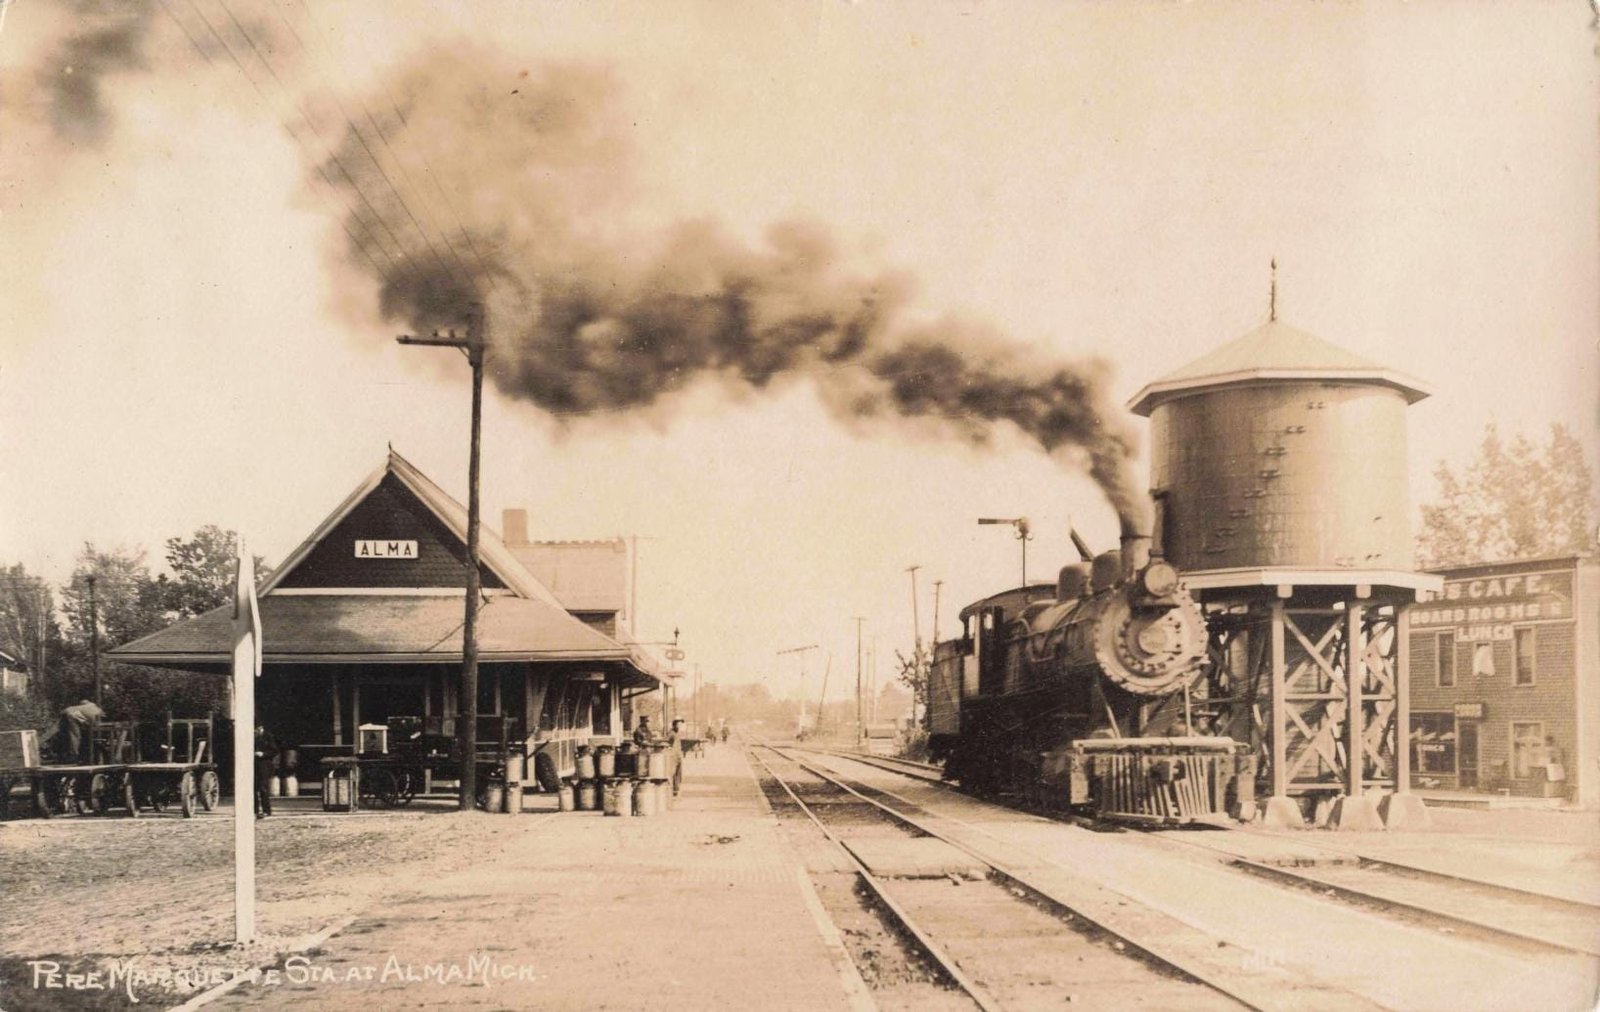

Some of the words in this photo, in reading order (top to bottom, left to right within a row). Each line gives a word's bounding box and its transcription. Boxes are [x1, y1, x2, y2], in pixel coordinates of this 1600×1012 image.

[361, 541, 412, 556] ALMA
[1468, 575, 1541, 597] CAFE
[1468, 603, 1541, 620] ROOMS
[1457, 625, 1513, 641] LUNCH
